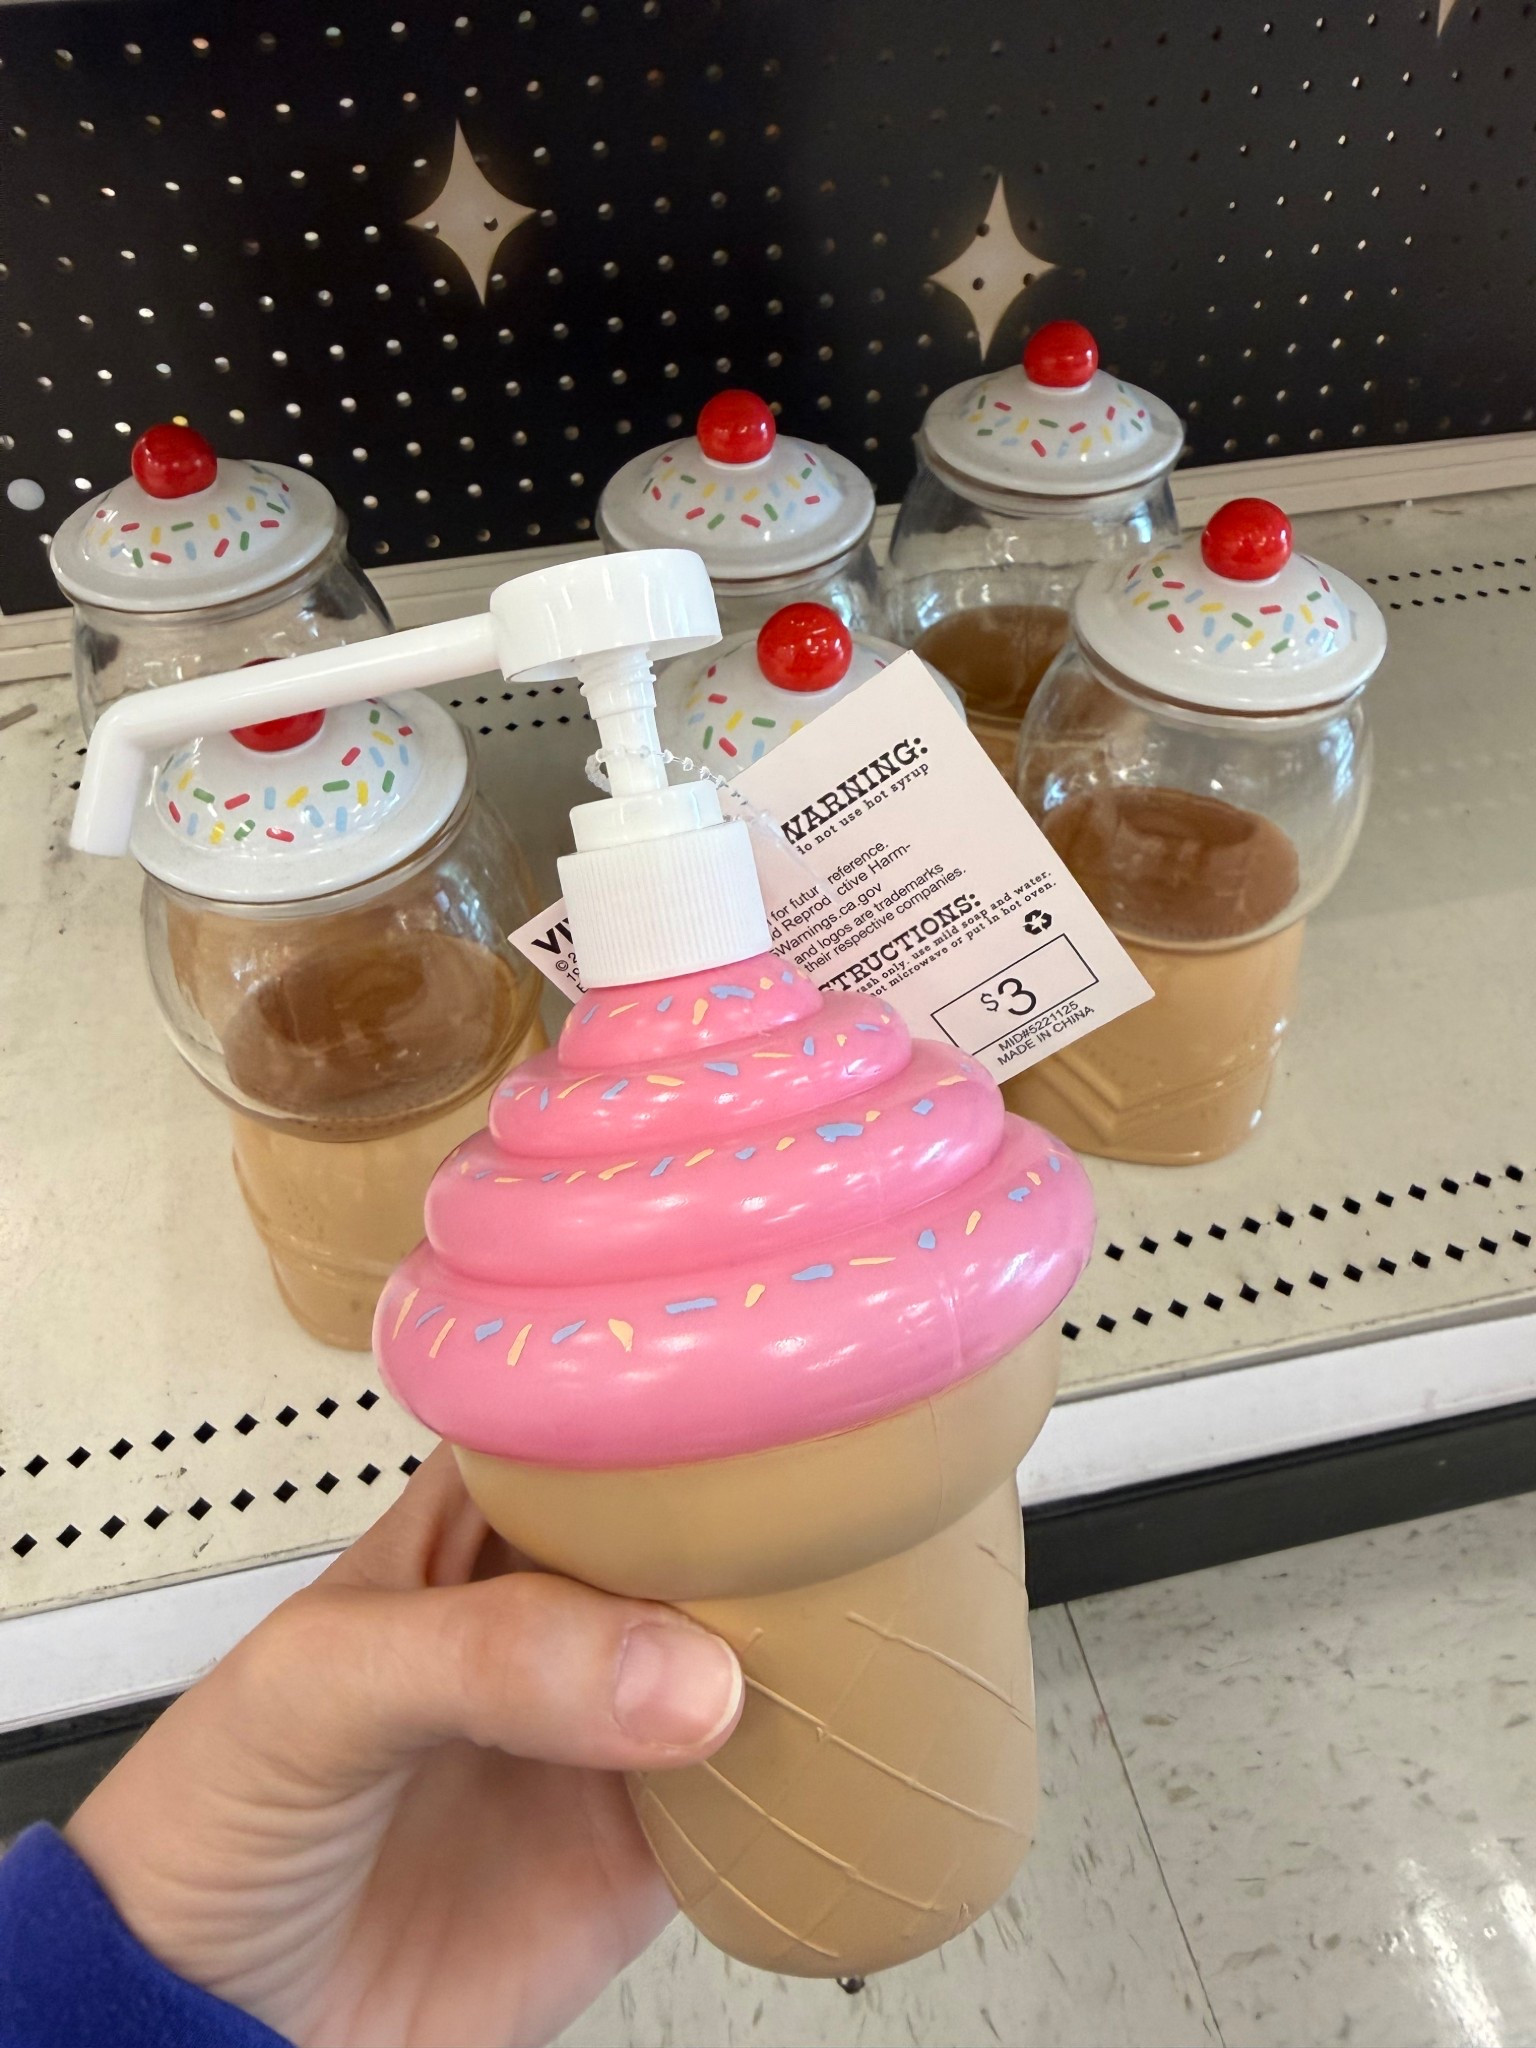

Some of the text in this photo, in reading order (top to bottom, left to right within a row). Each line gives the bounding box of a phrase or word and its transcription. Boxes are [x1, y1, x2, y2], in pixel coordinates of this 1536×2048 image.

[780, 737, 928, 845] WARNING:
[814, 825, 838, 844] not
[838, 808, 863, 827] use
[862, 790, 889, 810] hot
[890, 763, 929, 793] syrup
[770, 842, 889, 922] for futur reference.
[781, 872, 869, 932] Reprodctive
[867, 844, 911, 875] Harm-
[794, 864, 944, 965] and logos are trademarks
[803, 868, 966, 973] their respective companies.
[530, 917, 574, 955] VI
[881, 960, 910, 979] only.
[911, 945, 931, 960] use
[932, 925, 960, 947] mild
[961, 909, 988, 929] soap
[990, 892, 1012, 911] and
[1013, 871, 1051, 895] water.
[888, 947, 948, 987] microwave
[950, 936, 963, 948] or
[965, 923, 986, 941] put
[1000, 900, 1022, 916] hot
[1024, 882, 1057, 902] oven.
[980, 977, 1037, 1016] $3
[997, 1006, 1095, 1066] MADE IN CHINA
[998, 1000, 1079, 1056] MID#5221125
